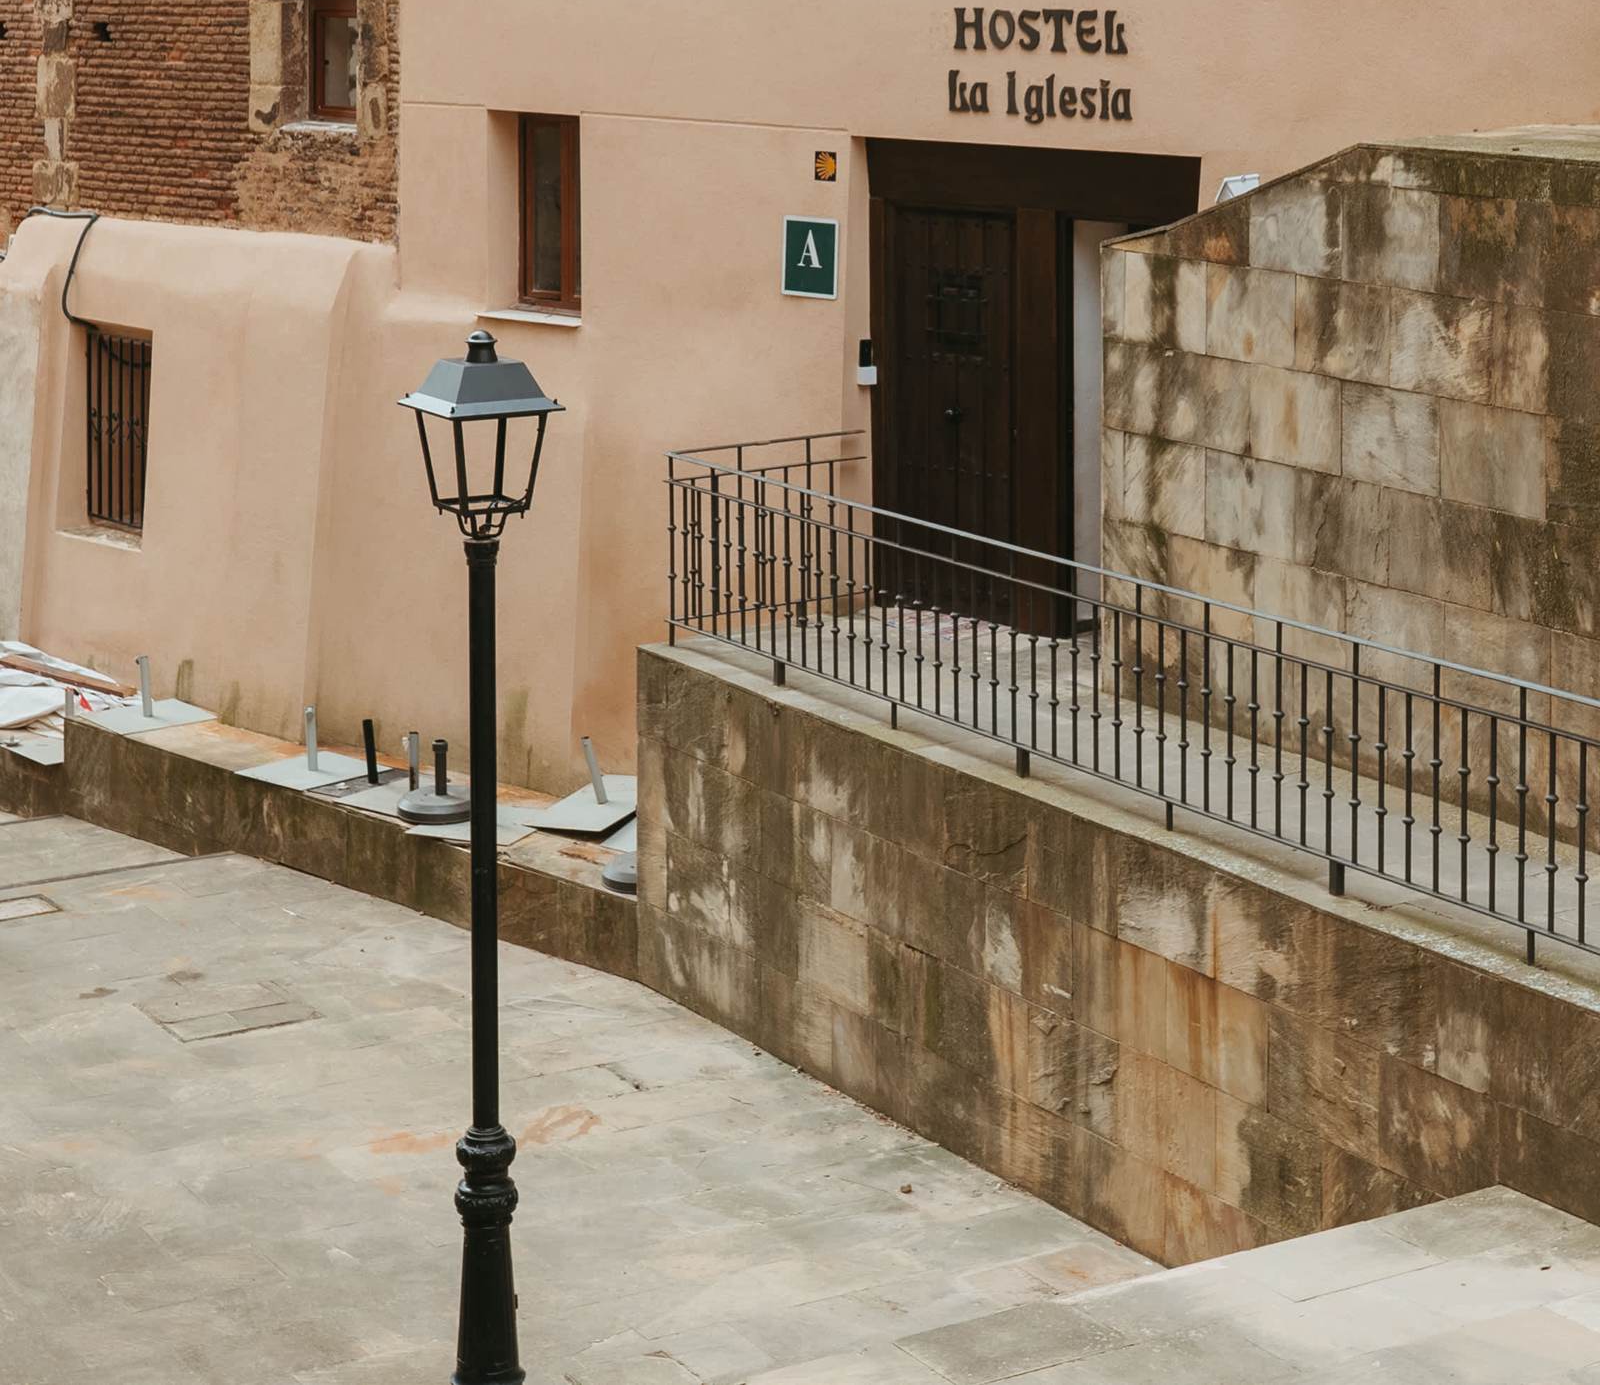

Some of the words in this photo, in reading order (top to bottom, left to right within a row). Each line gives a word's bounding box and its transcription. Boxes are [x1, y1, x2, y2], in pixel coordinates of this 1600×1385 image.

[953, 7, 1128, 54] HOSTEL
[948, 69, 990, 113] La
[1006, 70, 1133, 124] Iglesia
[797, 229, 823, 268] A
